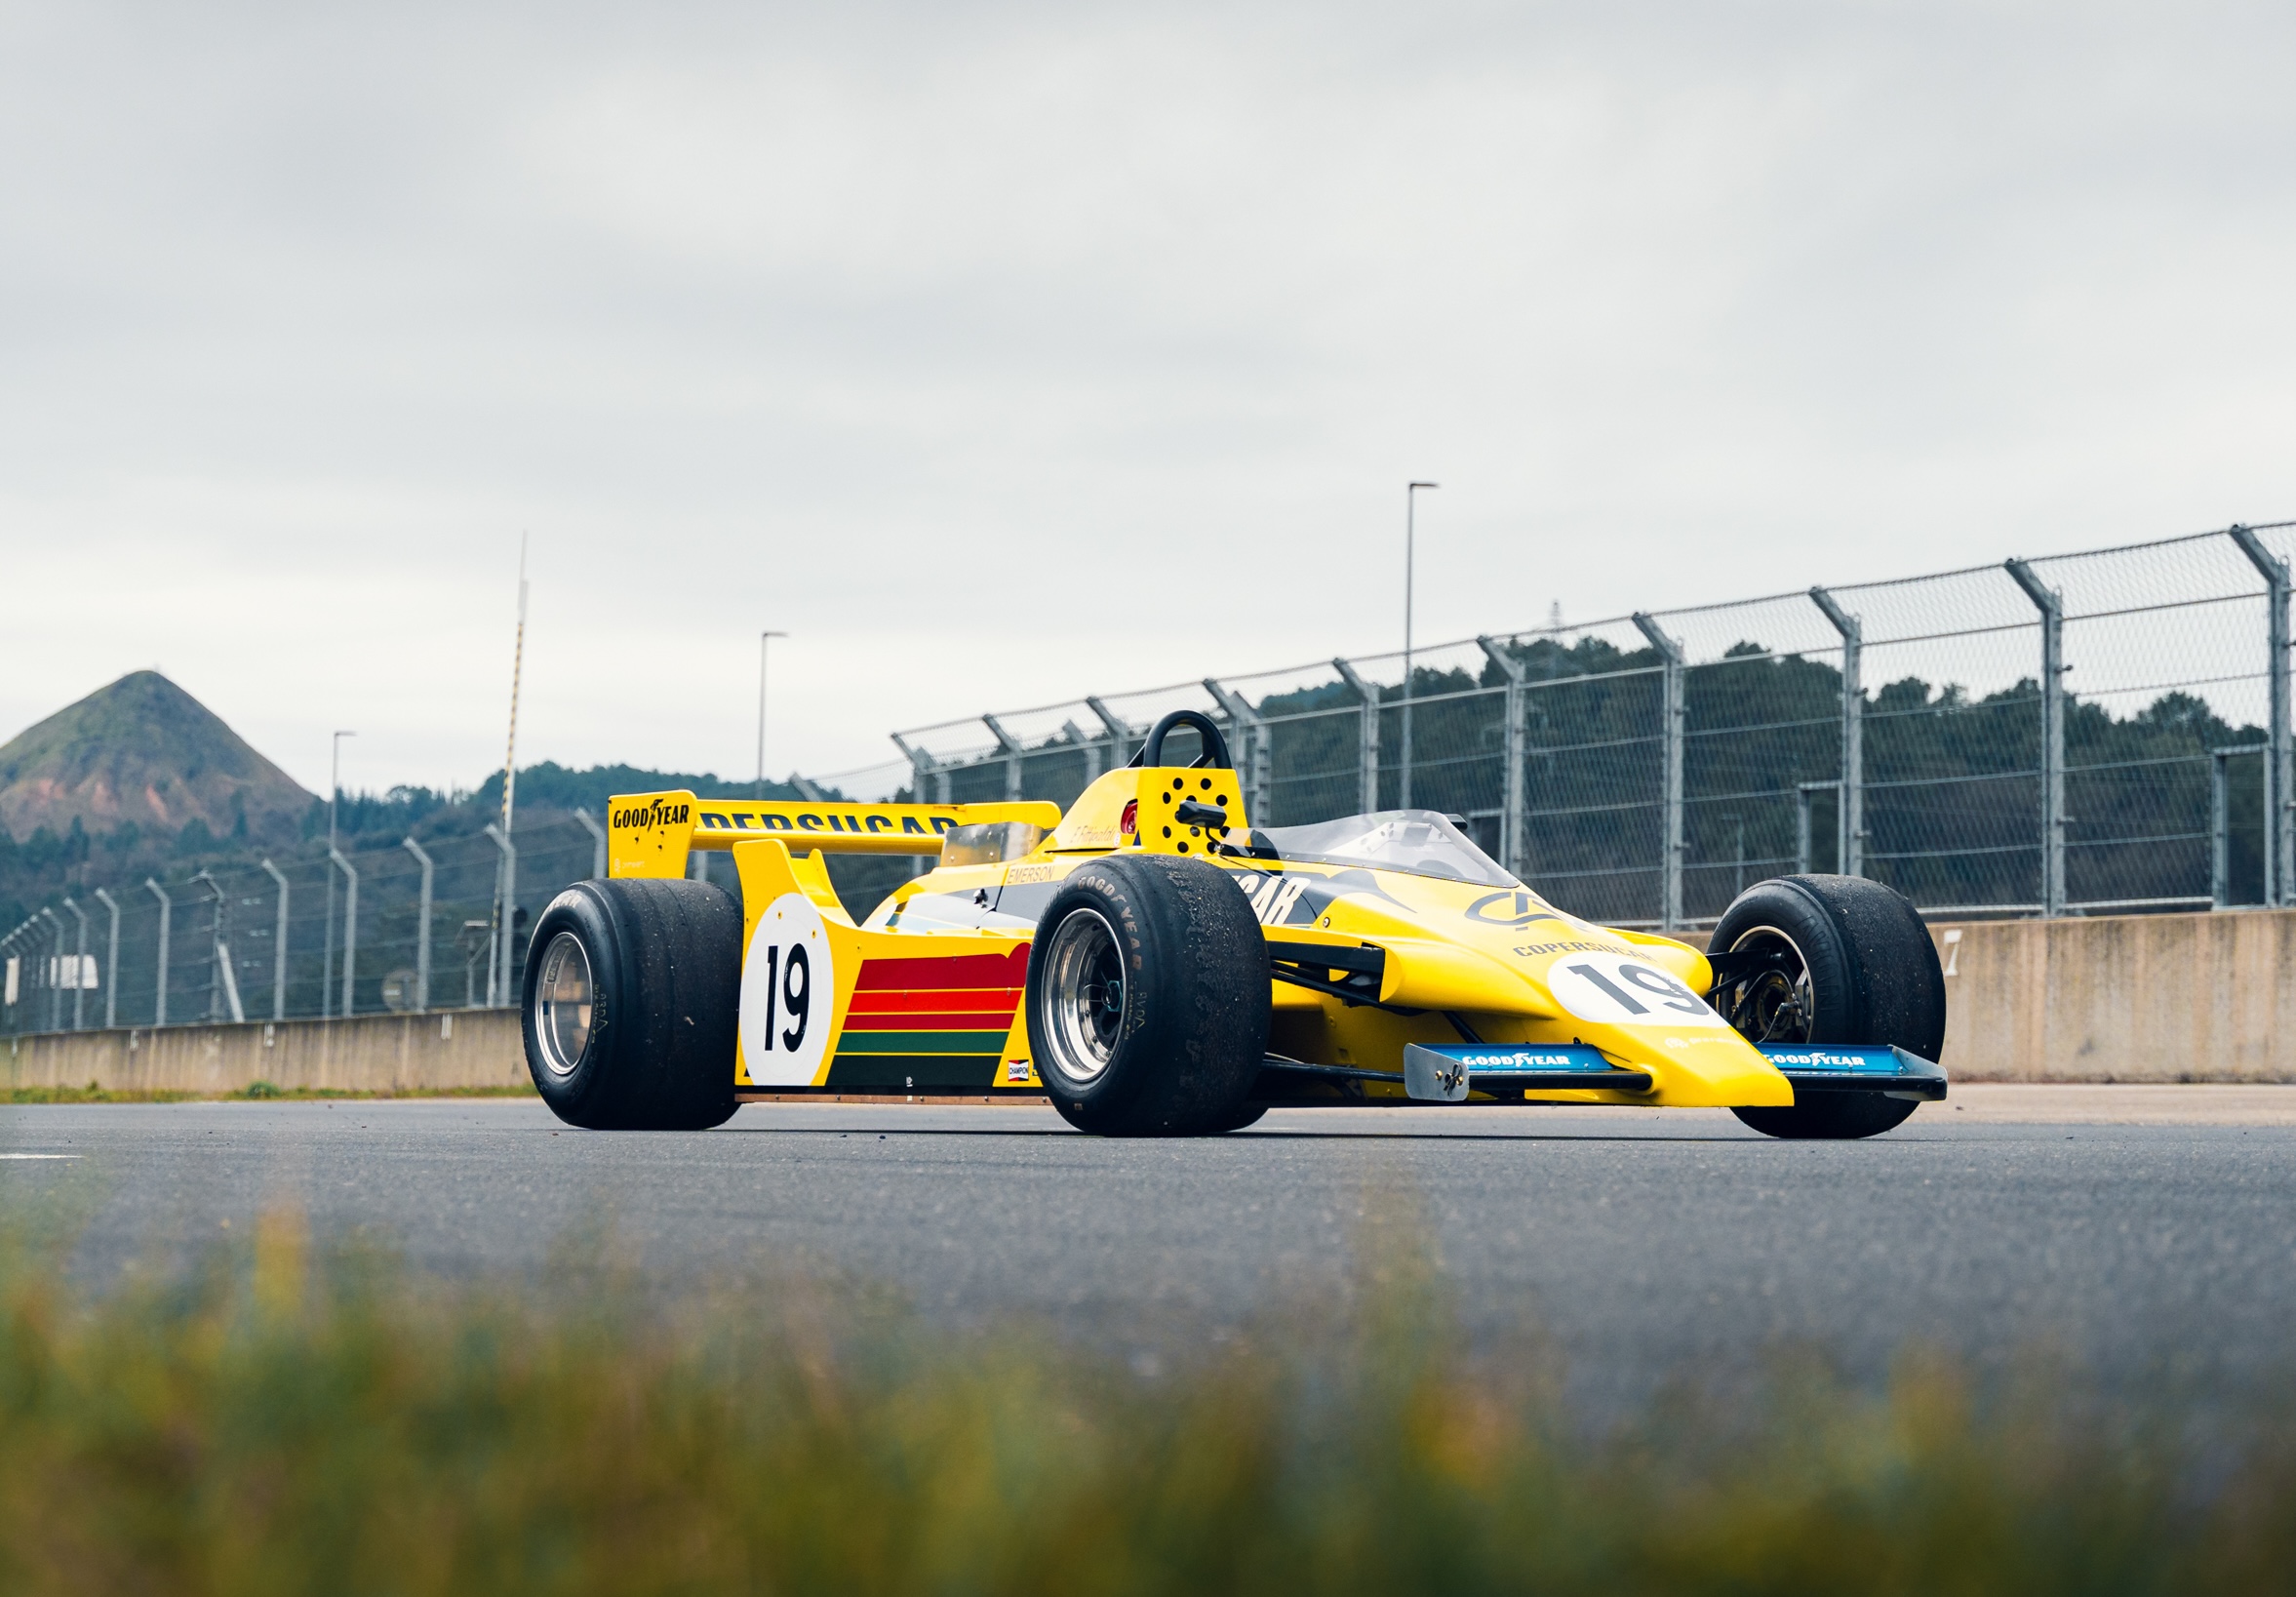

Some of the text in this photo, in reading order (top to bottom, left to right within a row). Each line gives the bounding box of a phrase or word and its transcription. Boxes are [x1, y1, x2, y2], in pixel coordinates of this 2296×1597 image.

[614, 801, 690, 829] GOODYEAR
[1007, 866, 1055, 884] EMERSON
[1513, 941, 1657, 963] COPERSUCAR
[1944, 930, 1963, 977] 7
[765, 942, 811, 1053] 19
[1566, 964, 1710, 1016] 19
[1463, 1054, 1571, 1066] GOODYEAR
[1765, 1054, 1866, 1066] GOODYEAR
